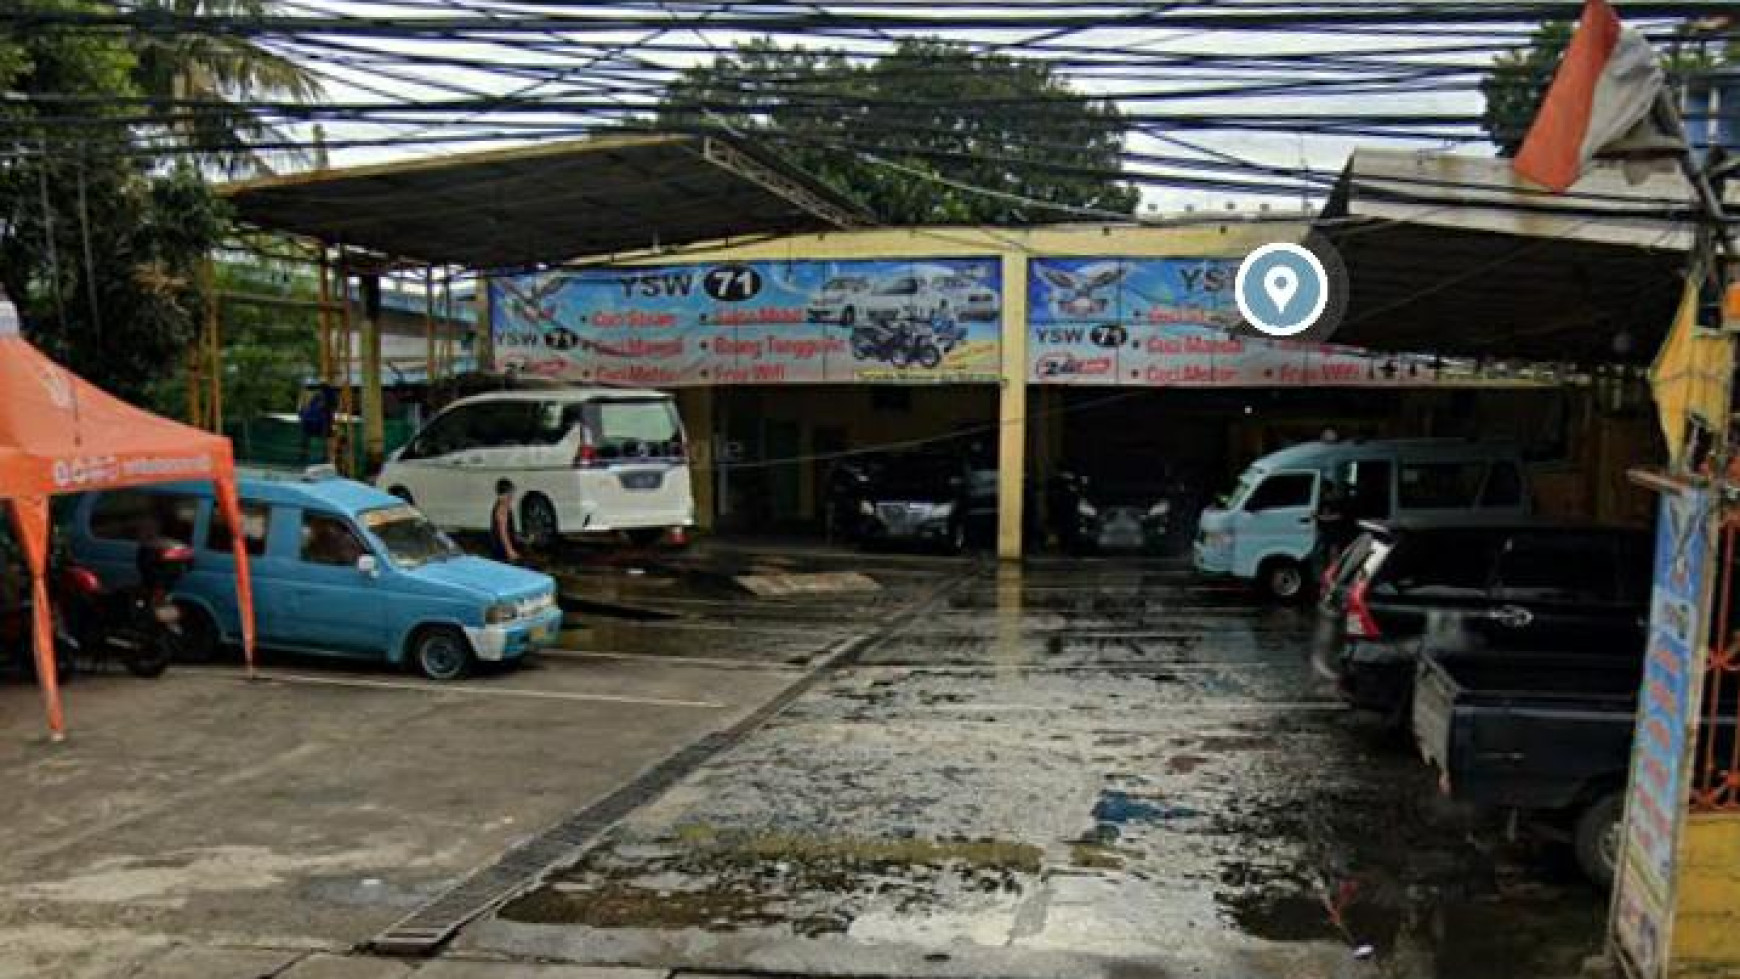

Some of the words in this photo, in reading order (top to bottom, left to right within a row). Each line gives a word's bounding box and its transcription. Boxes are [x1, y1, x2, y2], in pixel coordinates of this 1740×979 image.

[621, 275, 692, 298] YSW
[712, 271, 752, 297] 71
[1178, 267, 1238, 292] YS
[1036, 328, 1084, 344] YSW
